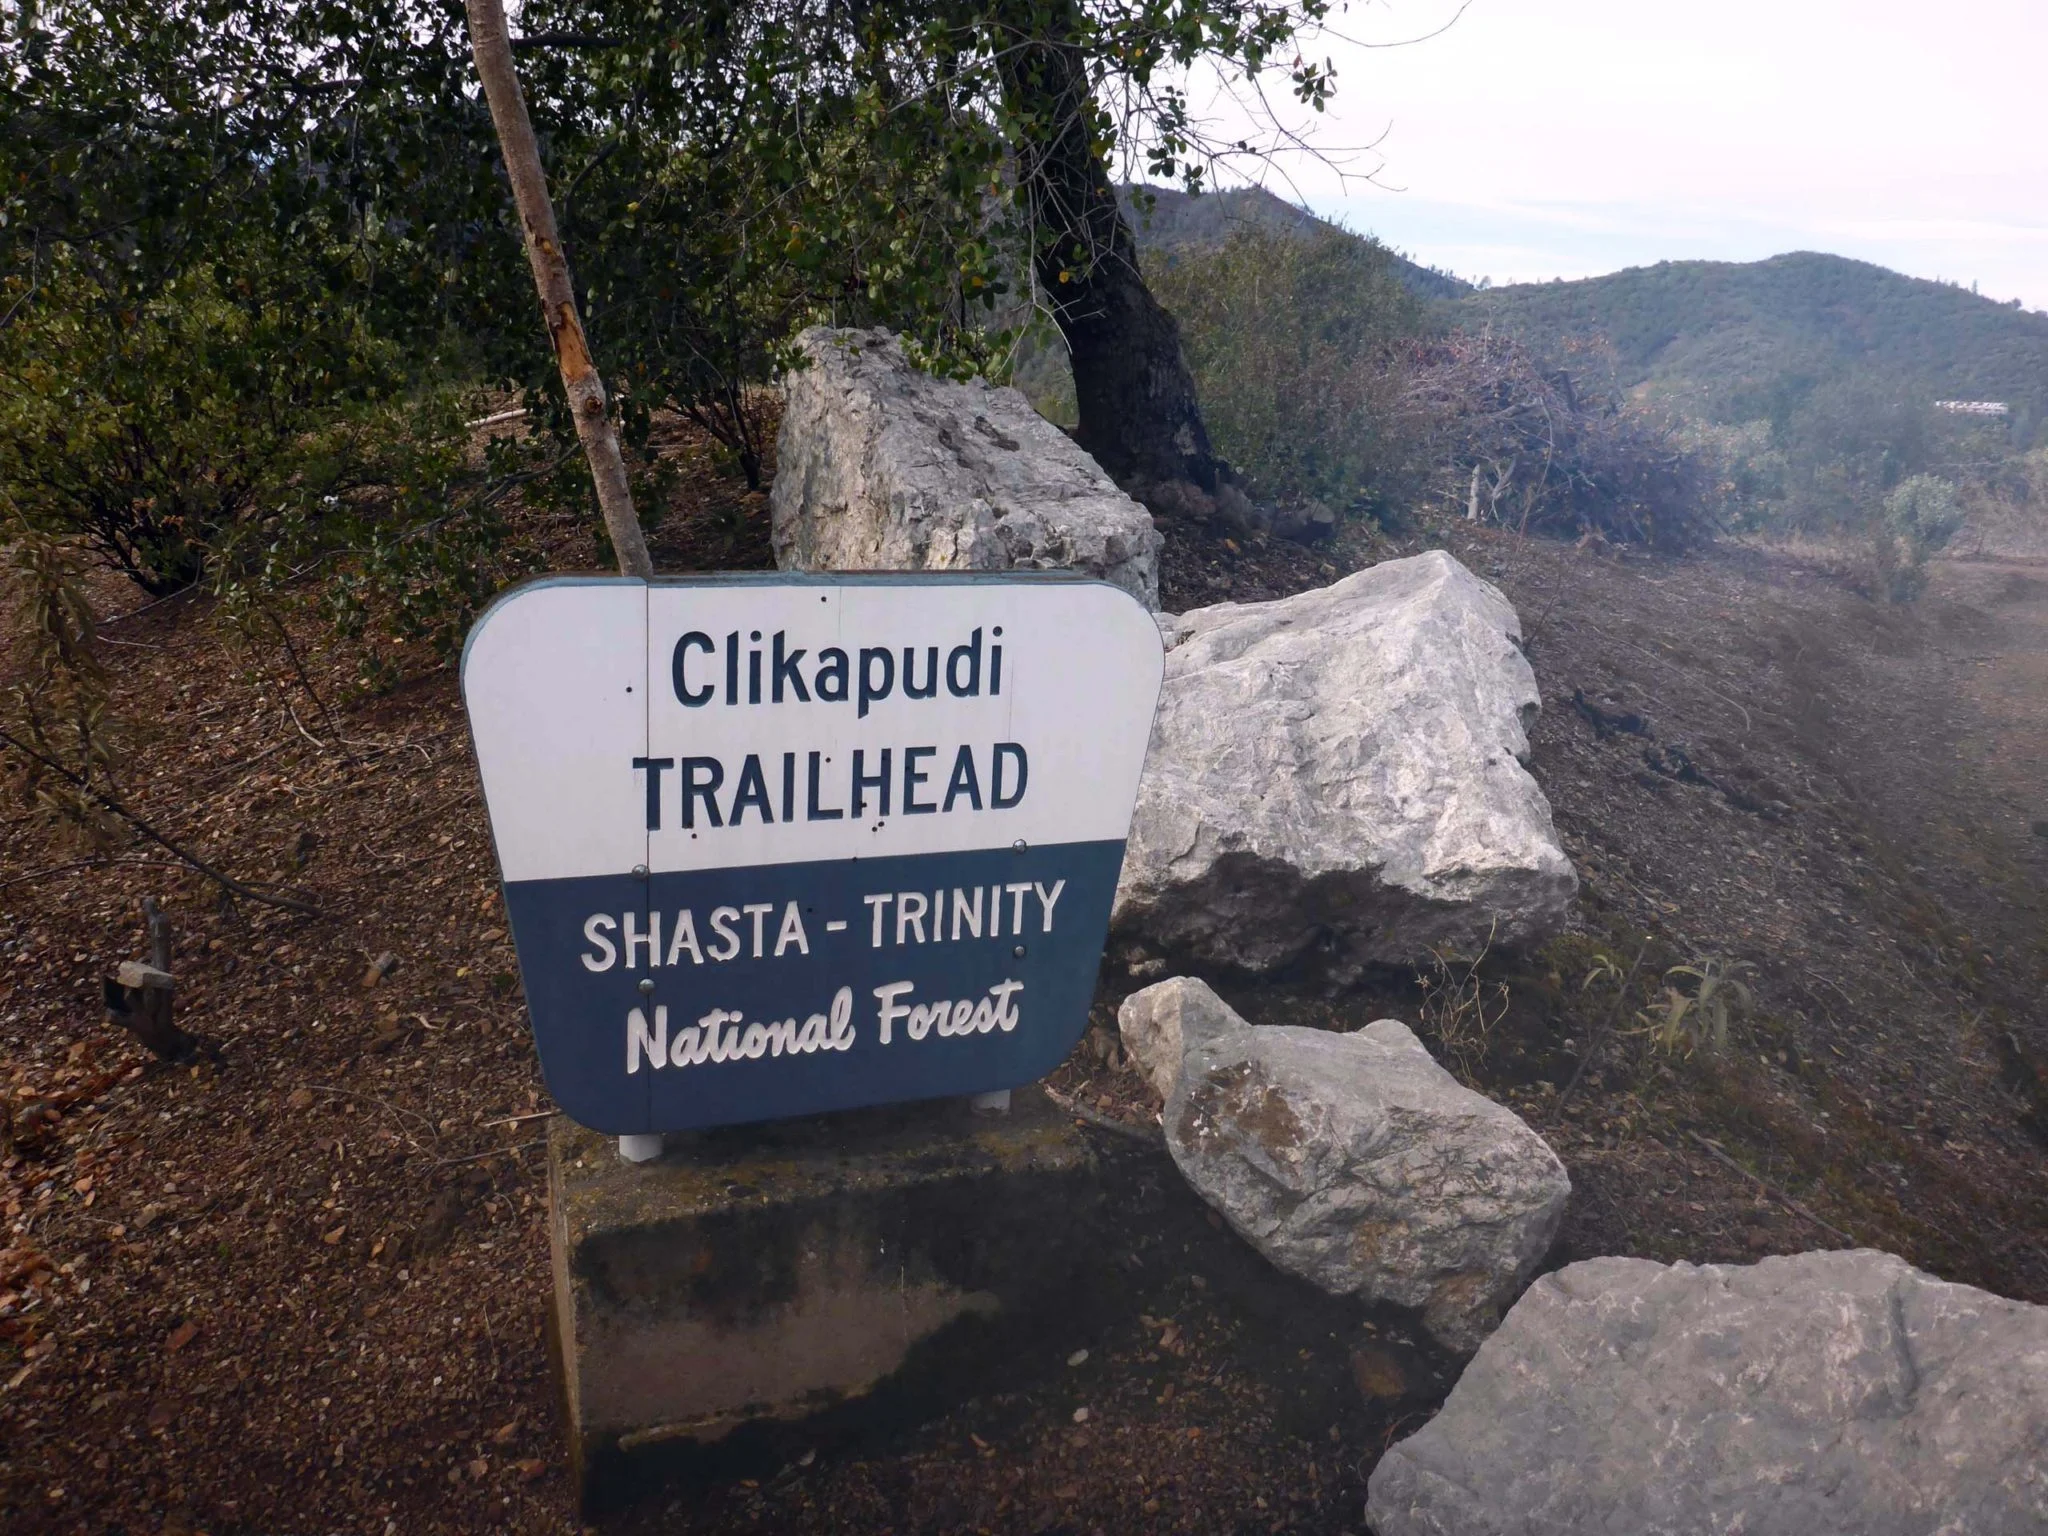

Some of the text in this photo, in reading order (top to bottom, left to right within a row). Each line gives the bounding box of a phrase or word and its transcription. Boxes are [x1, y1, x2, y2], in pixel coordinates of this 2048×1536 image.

[672, 625, 1003, 719] Clikapudi
[633, 742, 1029, 830] TRAILHEAD
[581, 901, 810, 973] SHASTA
[863, 879, 1066, 948] TRINITY
[626, 978, 1025, 1075] National Forest
